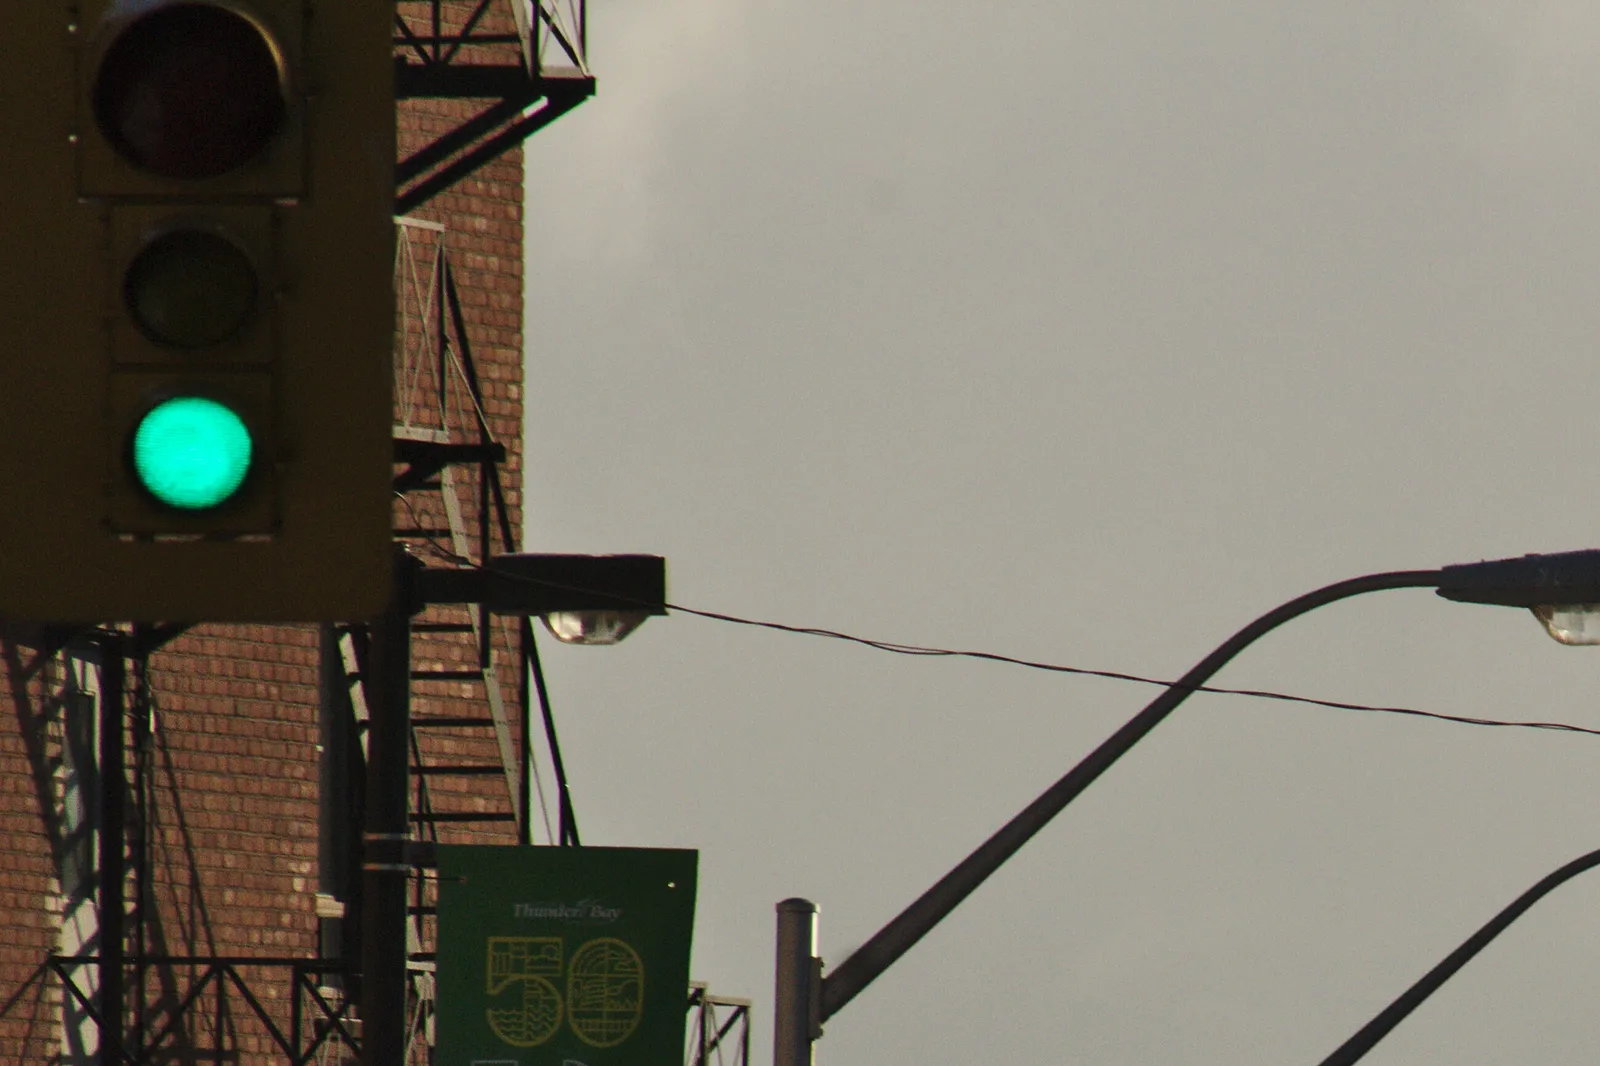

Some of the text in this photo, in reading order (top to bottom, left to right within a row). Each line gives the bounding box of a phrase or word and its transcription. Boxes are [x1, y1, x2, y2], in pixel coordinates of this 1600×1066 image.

[513, 903, 623, 922] Thunder Bay
[487, 937, 645, 1048] 50
